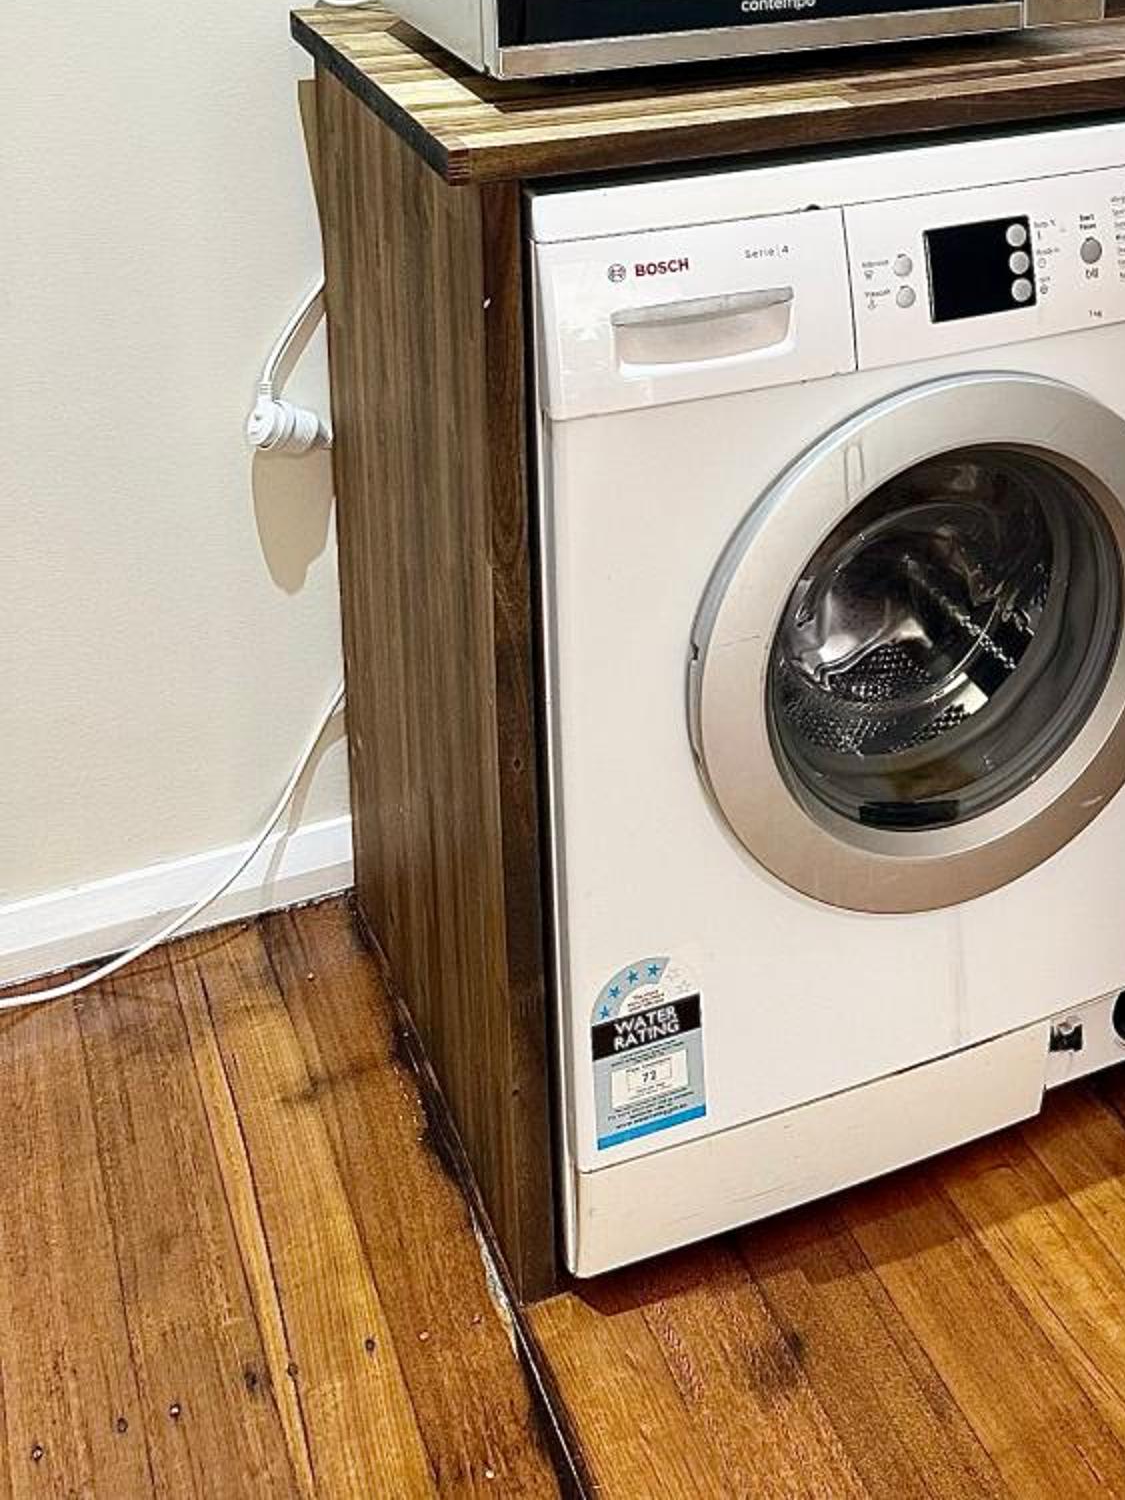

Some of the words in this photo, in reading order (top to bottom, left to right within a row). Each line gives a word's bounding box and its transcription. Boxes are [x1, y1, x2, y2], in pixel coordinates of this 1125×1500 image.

[634, 257, 690, 277] BOSCH
[614, 1005, 679, 1035] WATER
[613, 1021, 681, 1051] RATING
